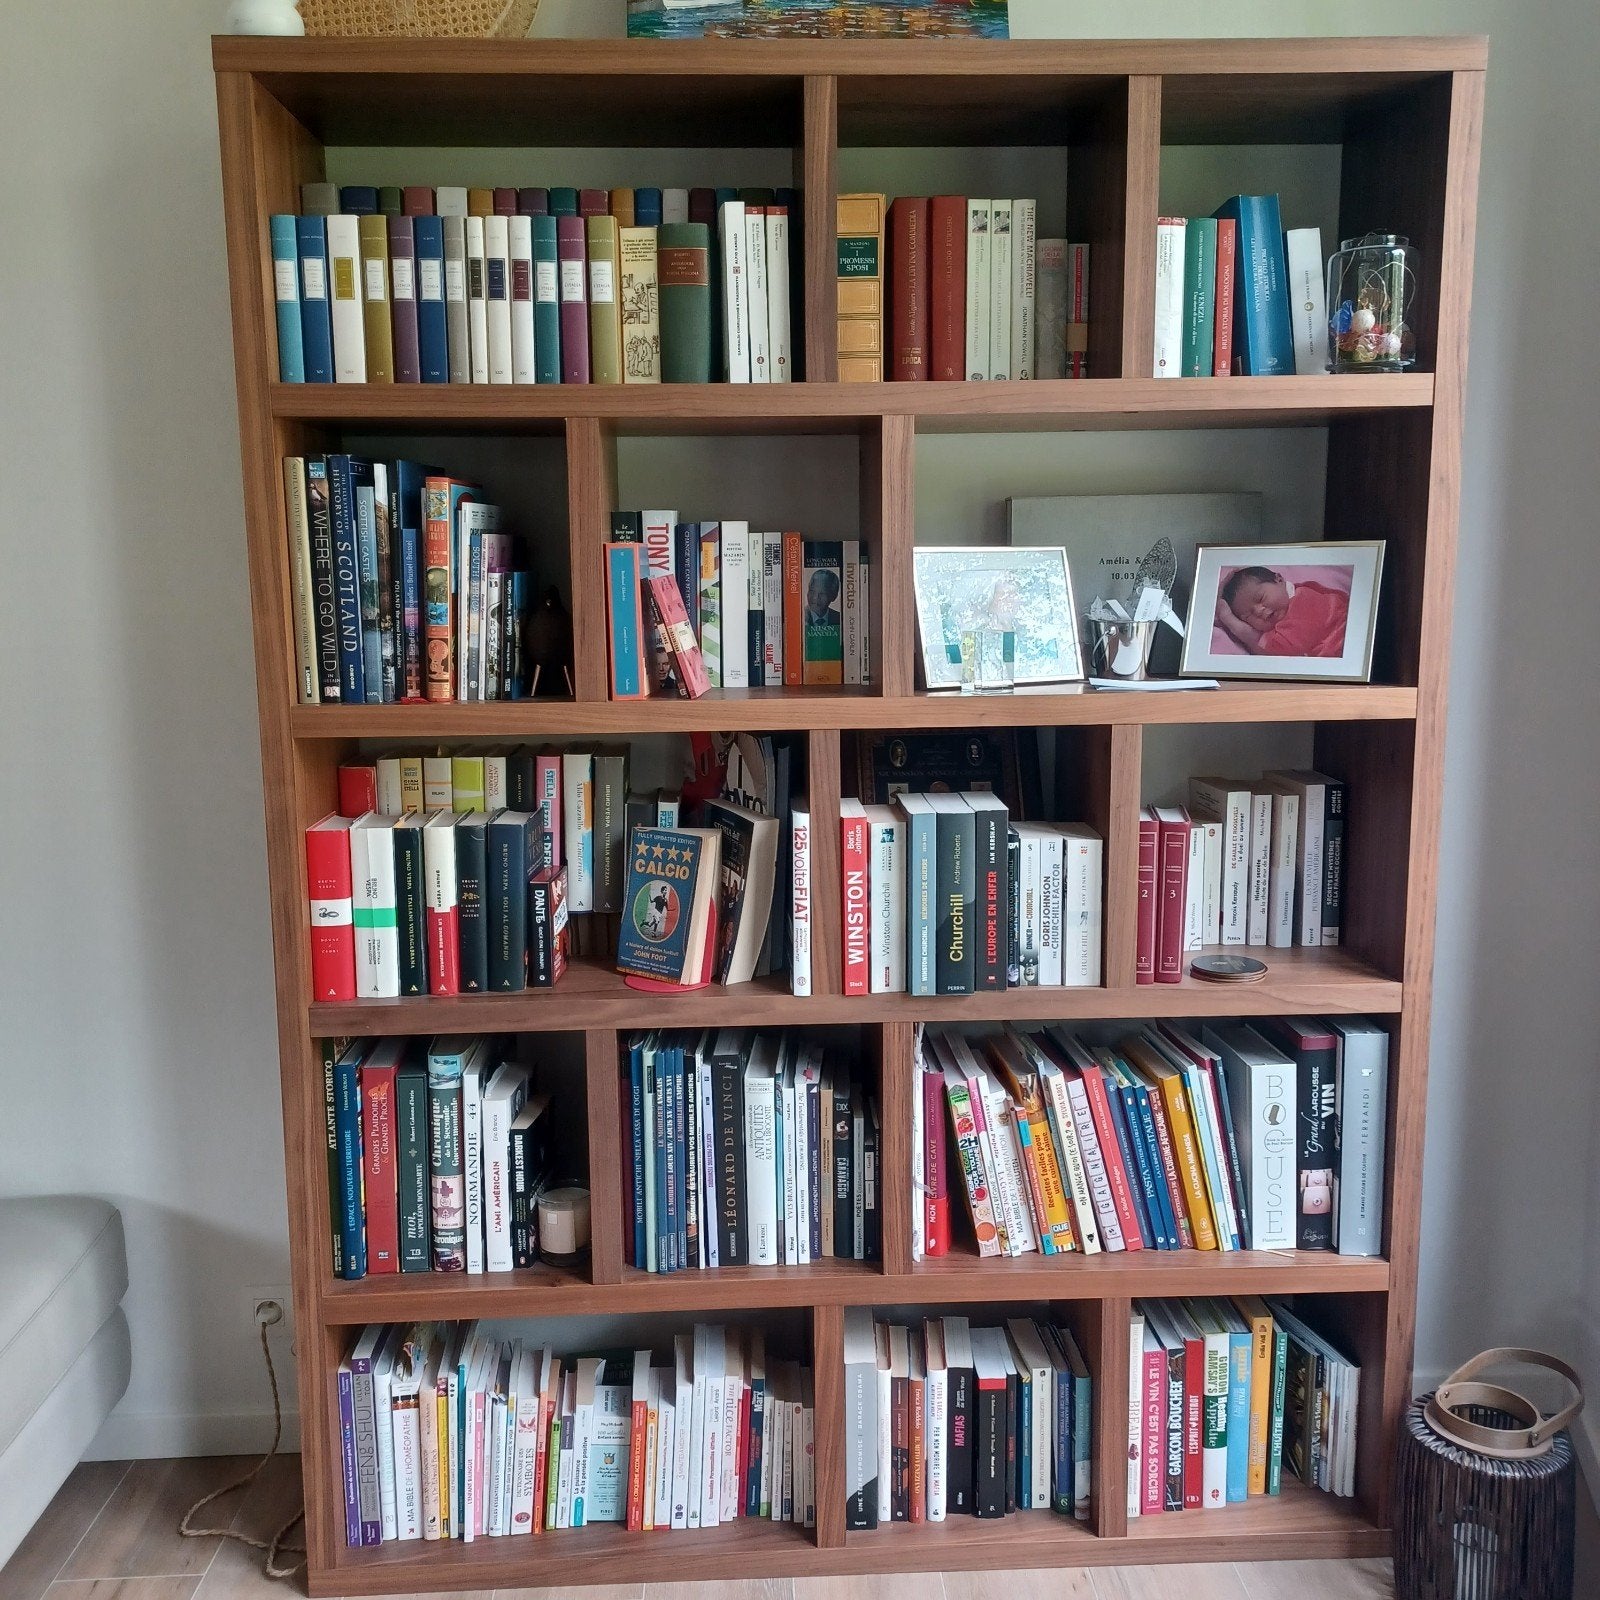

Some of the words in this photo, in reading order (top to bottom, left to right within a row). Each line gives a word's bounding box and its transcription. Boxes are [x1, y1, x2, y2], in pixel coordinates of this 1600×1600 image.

[1026, 206, 1034, 222] THE
[909, 210, 918, 250] COMMEDIA
[1026, 224, 1034, 244] NEW
[840, 256, 876, 265] PROMESSI
[846, 264, 870, 272] SPOSI
[909, 250, 917, 277] DIVINA
[1025, 245, 1034, 299] MACHIAVELLI
[1223, 264, 1231, 297] BOLOGNA
[1197, 291, 1205, 323] VENEZIA
[1222, 297, 1229, 306] DI
[1222, 306, 1230, 330] STORIA
[1221, 331, 1229, 350] BREVE
[332, 468, 344, 516] HISTORY
[335, 520, 344, 536] OF
[360, 499, 369, 543] SCOTTISH
[313, 510, 331, 569] WHERE
[647, 523, 670, 573] TONY
[772, 543, 782, 566] FEMMES
[789, 537, 800, 564] C'était
[361, 545, 371, 584] CASTLES
[472, 546, 480, 578] SOUTH
[764, 543, 773, 577] PUISSANTES
[1099, 555, 1131, 566] Amélia
[1135, 556, 1143, 565] &
[317, 577, 333, 597] TO
[789, 565, 799, 595] Merkel
[337, 541, 358, 653] SCOTLAND
[472, 579, 480, 613] AFRICA
[319, 602, 335, 628] GO
[322, 632, 338, 673] WILD
[545, 769, 554, 799] STELLA
[846, 831, 855, 850] Boris
[854, 824, 863, 855] Johnson
[954, 834, 962, 860] Roberts
[988, 820, 996, 851] KERSHAW
[635, 858, 691, 882] CALCIO
[920, 858, 928, 881] GUERRE
[953, 860, 962, 885] Andrew
[988, 852, 997, 864] IAN
[920, 881, 928, 891] DE
[986, 871, 997, 901] ENFER
[1052, 863, 1061, 899] FACTOR
[534, 889, 546, 925] DANTE
[879, 882, 891, 919] Churchill
[919, 891, 928, 920] MÉMOIRES
[987, 904, 997, 916] EN
[1025, 887, 1034, 920] CHURCHILL
[1042, 876, 1051, 920] JOHNSON
[503, 914, 510, 925] AL
[847, 870, 864, 966] WINSTON
[949, 894, 964, 963] Churchill
[1042, 919, 1051, 947] BORIS
[1051, 900, 1061, 950] CHURCHILL
[880, 922, 891, 958] Winston
[920, 925, 928, 956] CHURCHILL
[986, 919, 997, 965] L'EUROPE
[1025, 929, 1033, 951] DINNER
[633, 949, 650, 961] JOHN
[650, 953, 667, 963] FOOT
[920, 957, 928, 982] WINSTON
[325, 1060, 335, 1103] STORICO
[1311, 1067, 1320, 1118] LAROUSSE
[379, 1092, 389, 1121] PROCÈS
[467, 1103, 476, 1120] 44
[721, 1074, 732, 1121] VINCI
[1321, 1083, 1336, 1119] VIN
[327, 1104, 338, 1149] ATLANTE
[370, 1092, 381, 1138] PLAIDOIRIES
[1142, 1112, 1154, 1143] ITALIE
[1361, 1088, 1371, 1145] FERRANDI
[344, 1129, 353, 1166] TERRITOIRE
[380, 1122, 389, 1155] GRANDS
[431, 1097, 444, 1167] Chronique
[724, 1126, 734, 1146] DE
[1035, 1133, 1047, 1154] pour
[371, 1139, 381, 1175] GRANDES
[514, 1133, 524, 1169] DARKEST
[929, 1138, 937, 1160] CAVE
[1078, 1110, 1111, 1209] GAGNAIRE
[415, 1163, 424, 1202] BONAPARTE
[467, 1132, 479, 1225] NORMANDIE
[515, 1169, 525, 1192] HOUR
[930, 1161, 937, 1173] DE
[1038, 1154, 1050, 1180] faciles
[346, 1167, 355, 1201] NOUVEAU
[491, 1161, 501, 1208] AMÉRICAIN
[724, 1152, 737, 1227] LÉONARD
[929, 1175, 937, 1199] LIVRE
[1043, 1180, 1056, 1209] Recettes
[1142, 1168, 1154, 1198] PASTA
[347, 1201, 356, 1232] L'ESPACE,
[406, 1211, 418, 1239] moi,
[416, 1203, 424, 1238] NAPOLÉON
[493, 1211, 502, 1233] L'AMI
[1148, 1367, 1160, 1379] LE
[1207, 1349, 1218, 1394] RAMSAY'S
[1218, 1355, 1228, 1393] GORDON
[753, 1390, 763, 1412] Marx
[1148, 1381, 1160, 1401] VIN
[1169, 1381, 1183, 1429] BOUCHER
[357, 1405, 372, 1442] SHUI
[1148, 1404, 1160, 1432] C'EST
[1188, 1395, 1199, 1422] BISTROT
[1206, 1399, 1219, 1447] Appetite
[1216, 1395, 1228, 1432] Healthy
[401, 1414, 412, 1476] L'HOMÉOPATHIE
[954, 1414, 965, 1447] MAFIAS
[1148, 1435, 1160, 1454] PAS
[1188, 1427, 1199, 1455] L'ESPRIT
[1272, 1416, 1283, 1456] L'HUÎTRE
[1168, 1432, 1184, 1476] GARÇON
[404, 1476, 412, 1487] DE
[525, 1448, 534, 1497] SYMBOLES
[1148, 1457, 1160, 1502] SORCIER
[405, 1487, 413, 1507] BIBLE
[406, 1508, 414, 1522] MA
